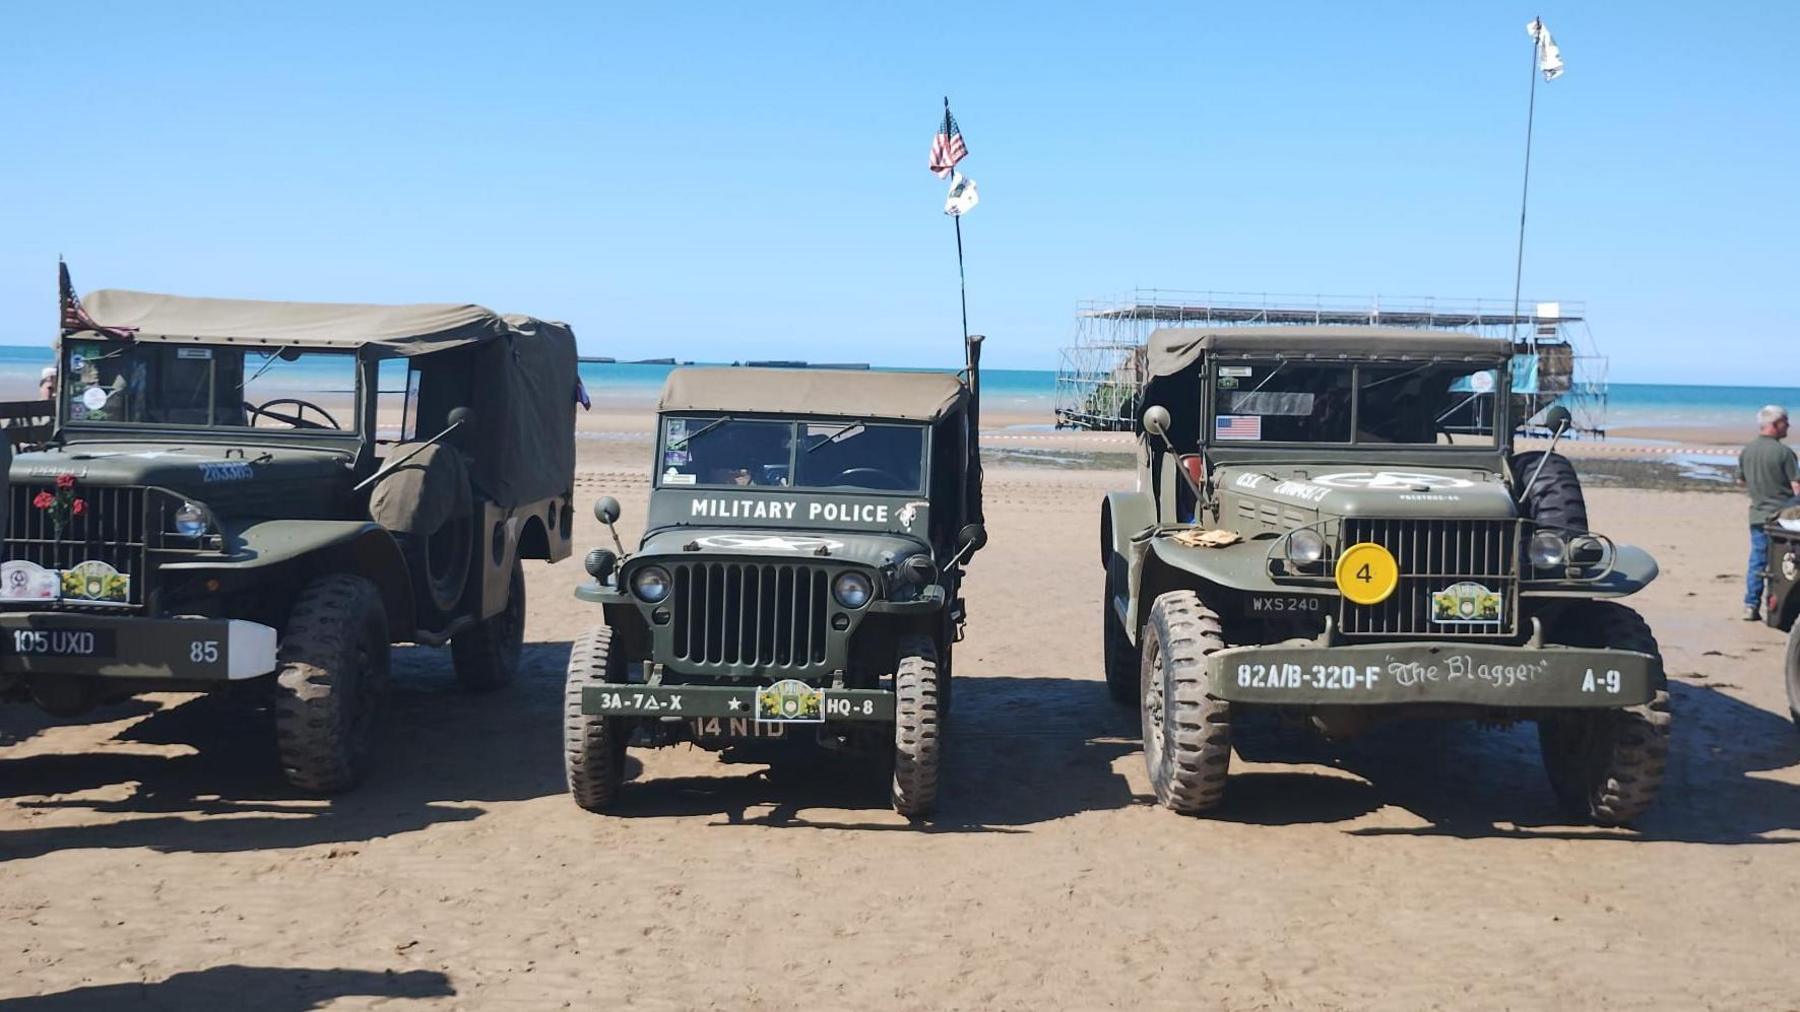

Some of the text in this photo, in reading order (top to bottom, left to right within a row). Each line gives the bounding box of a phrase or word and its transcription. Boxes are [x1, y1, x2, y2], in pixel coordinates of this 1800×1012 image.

[691, 499, 888, 523] MILITARY POLICE
[1356, 563, 1373, 583] 4
[1252, 597, 1319, 611] WXS 240
[14, 630, 94, 654] 105 UXD
[190, 641, 218, 663] 85
[1237, 663, 1381, 690] 82A/B-320-F
[1581, 668, 1621, 694] A-9
